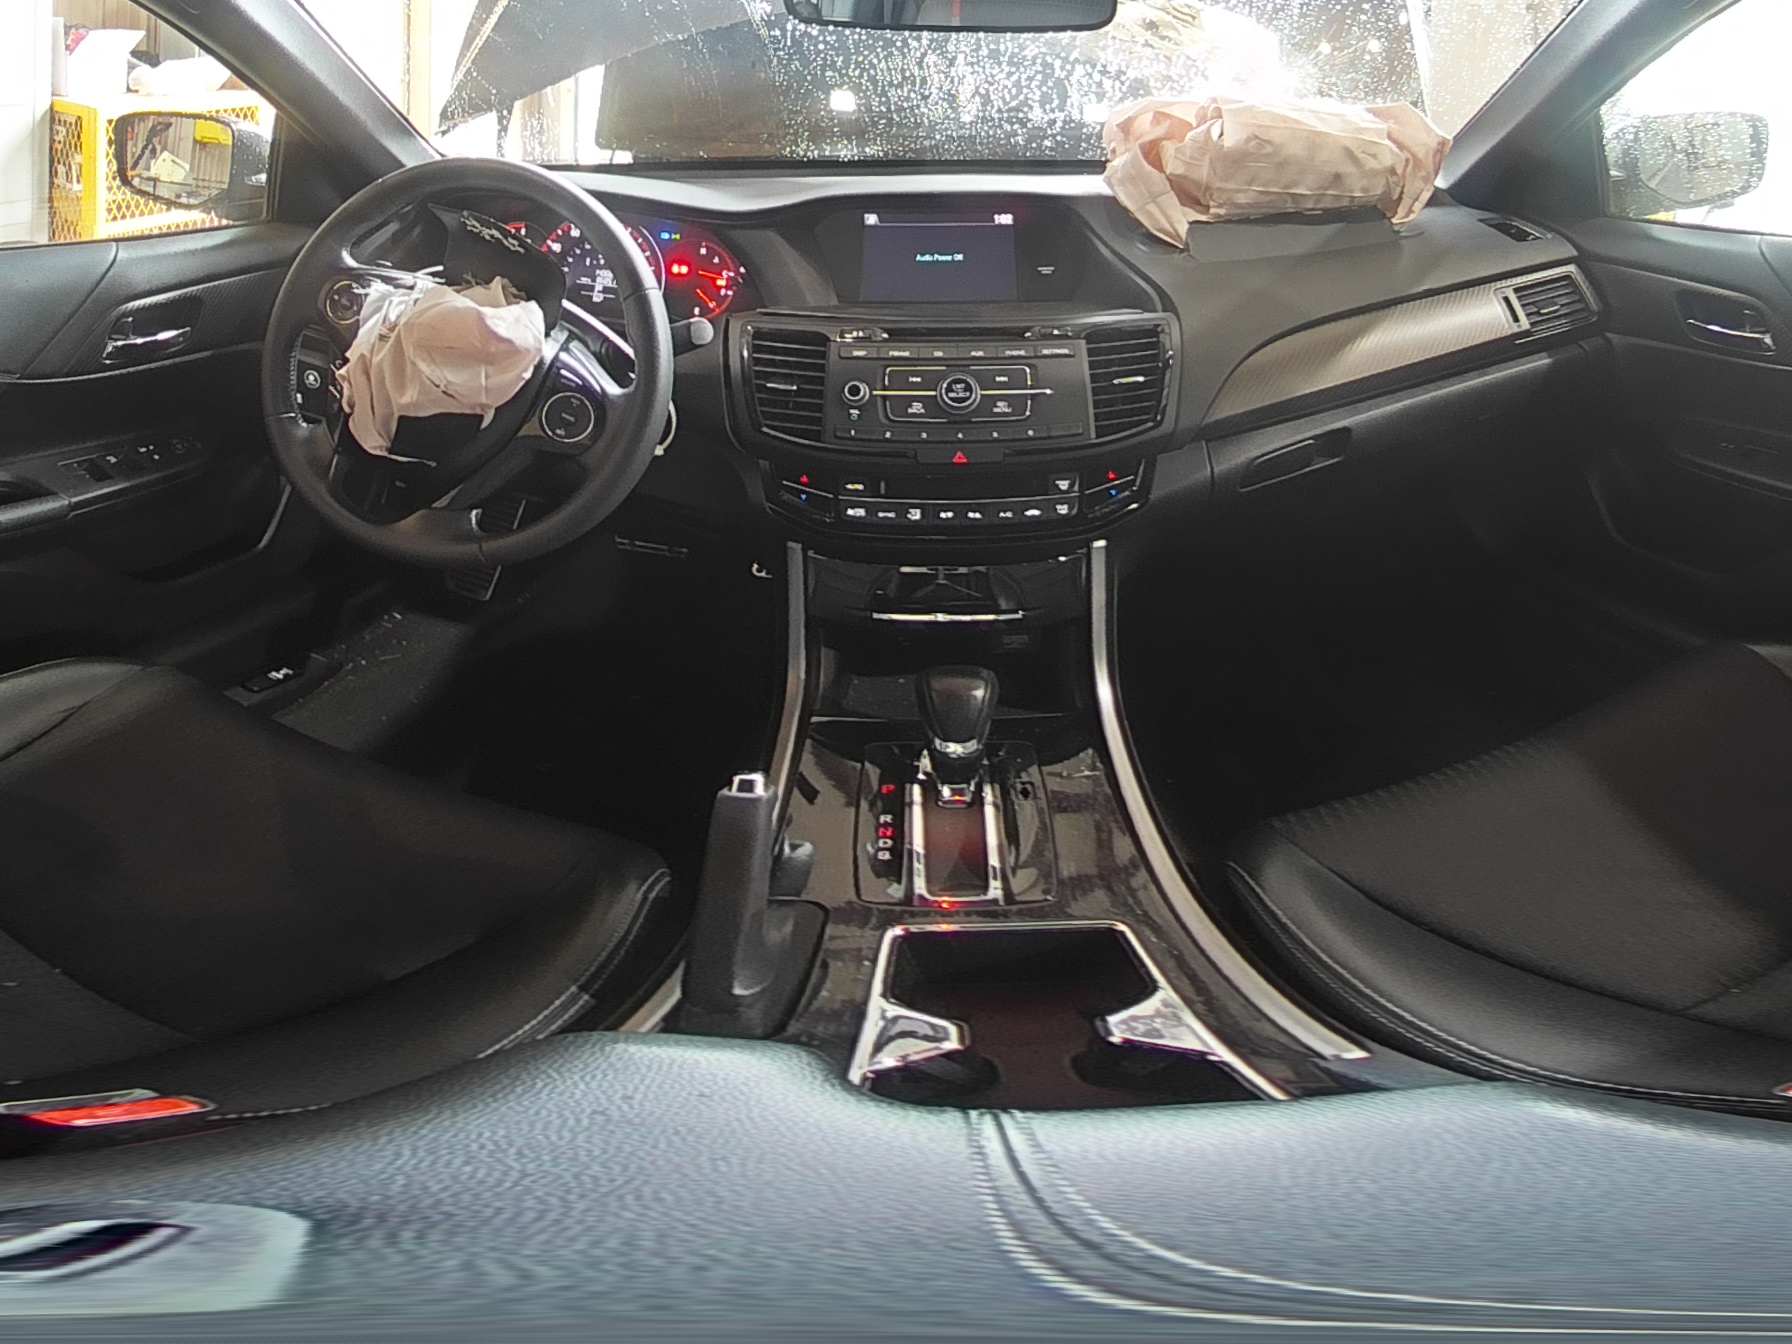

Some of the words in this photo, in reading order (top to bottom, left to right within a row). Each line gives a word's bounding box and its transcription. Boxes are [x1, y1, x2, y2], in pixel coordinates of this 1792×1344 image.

[915, 253, 933, 261] Audio
[933, 253, 953, 261] Power
[953, 253, 964, 261] Off
[881, 784, 896, 794] P
[879, 814, 894, 824] R
[878, 827, 895, 838] N
[878, 838, 894, 848] D
